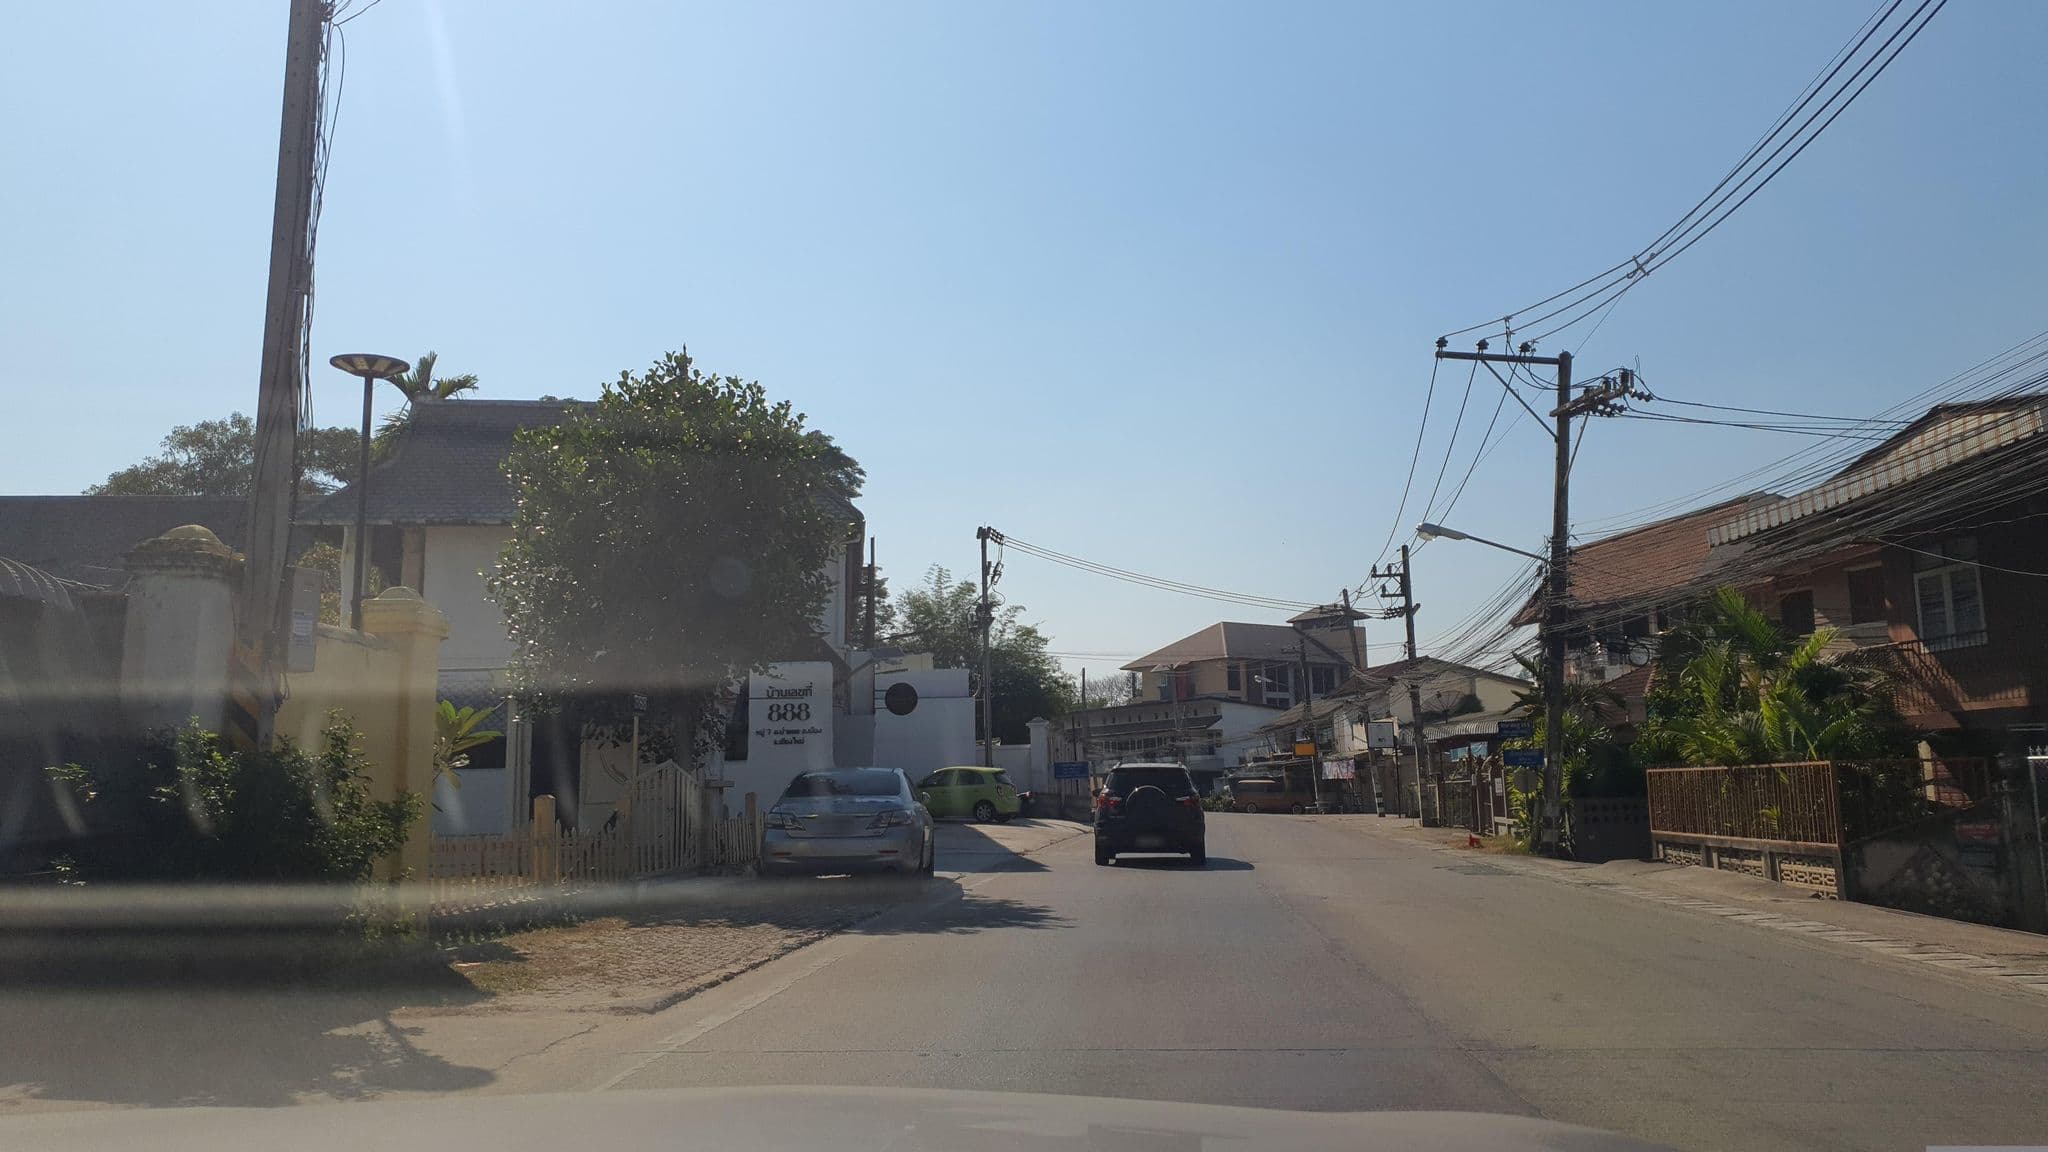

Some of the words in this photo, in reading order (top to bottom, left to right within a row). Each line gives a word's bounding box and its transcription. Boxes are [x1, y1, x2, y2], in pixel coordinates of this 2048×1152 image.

[766, 682, 813, 698] บ้านเลขที่
[768, 703, 811, 721] 888
